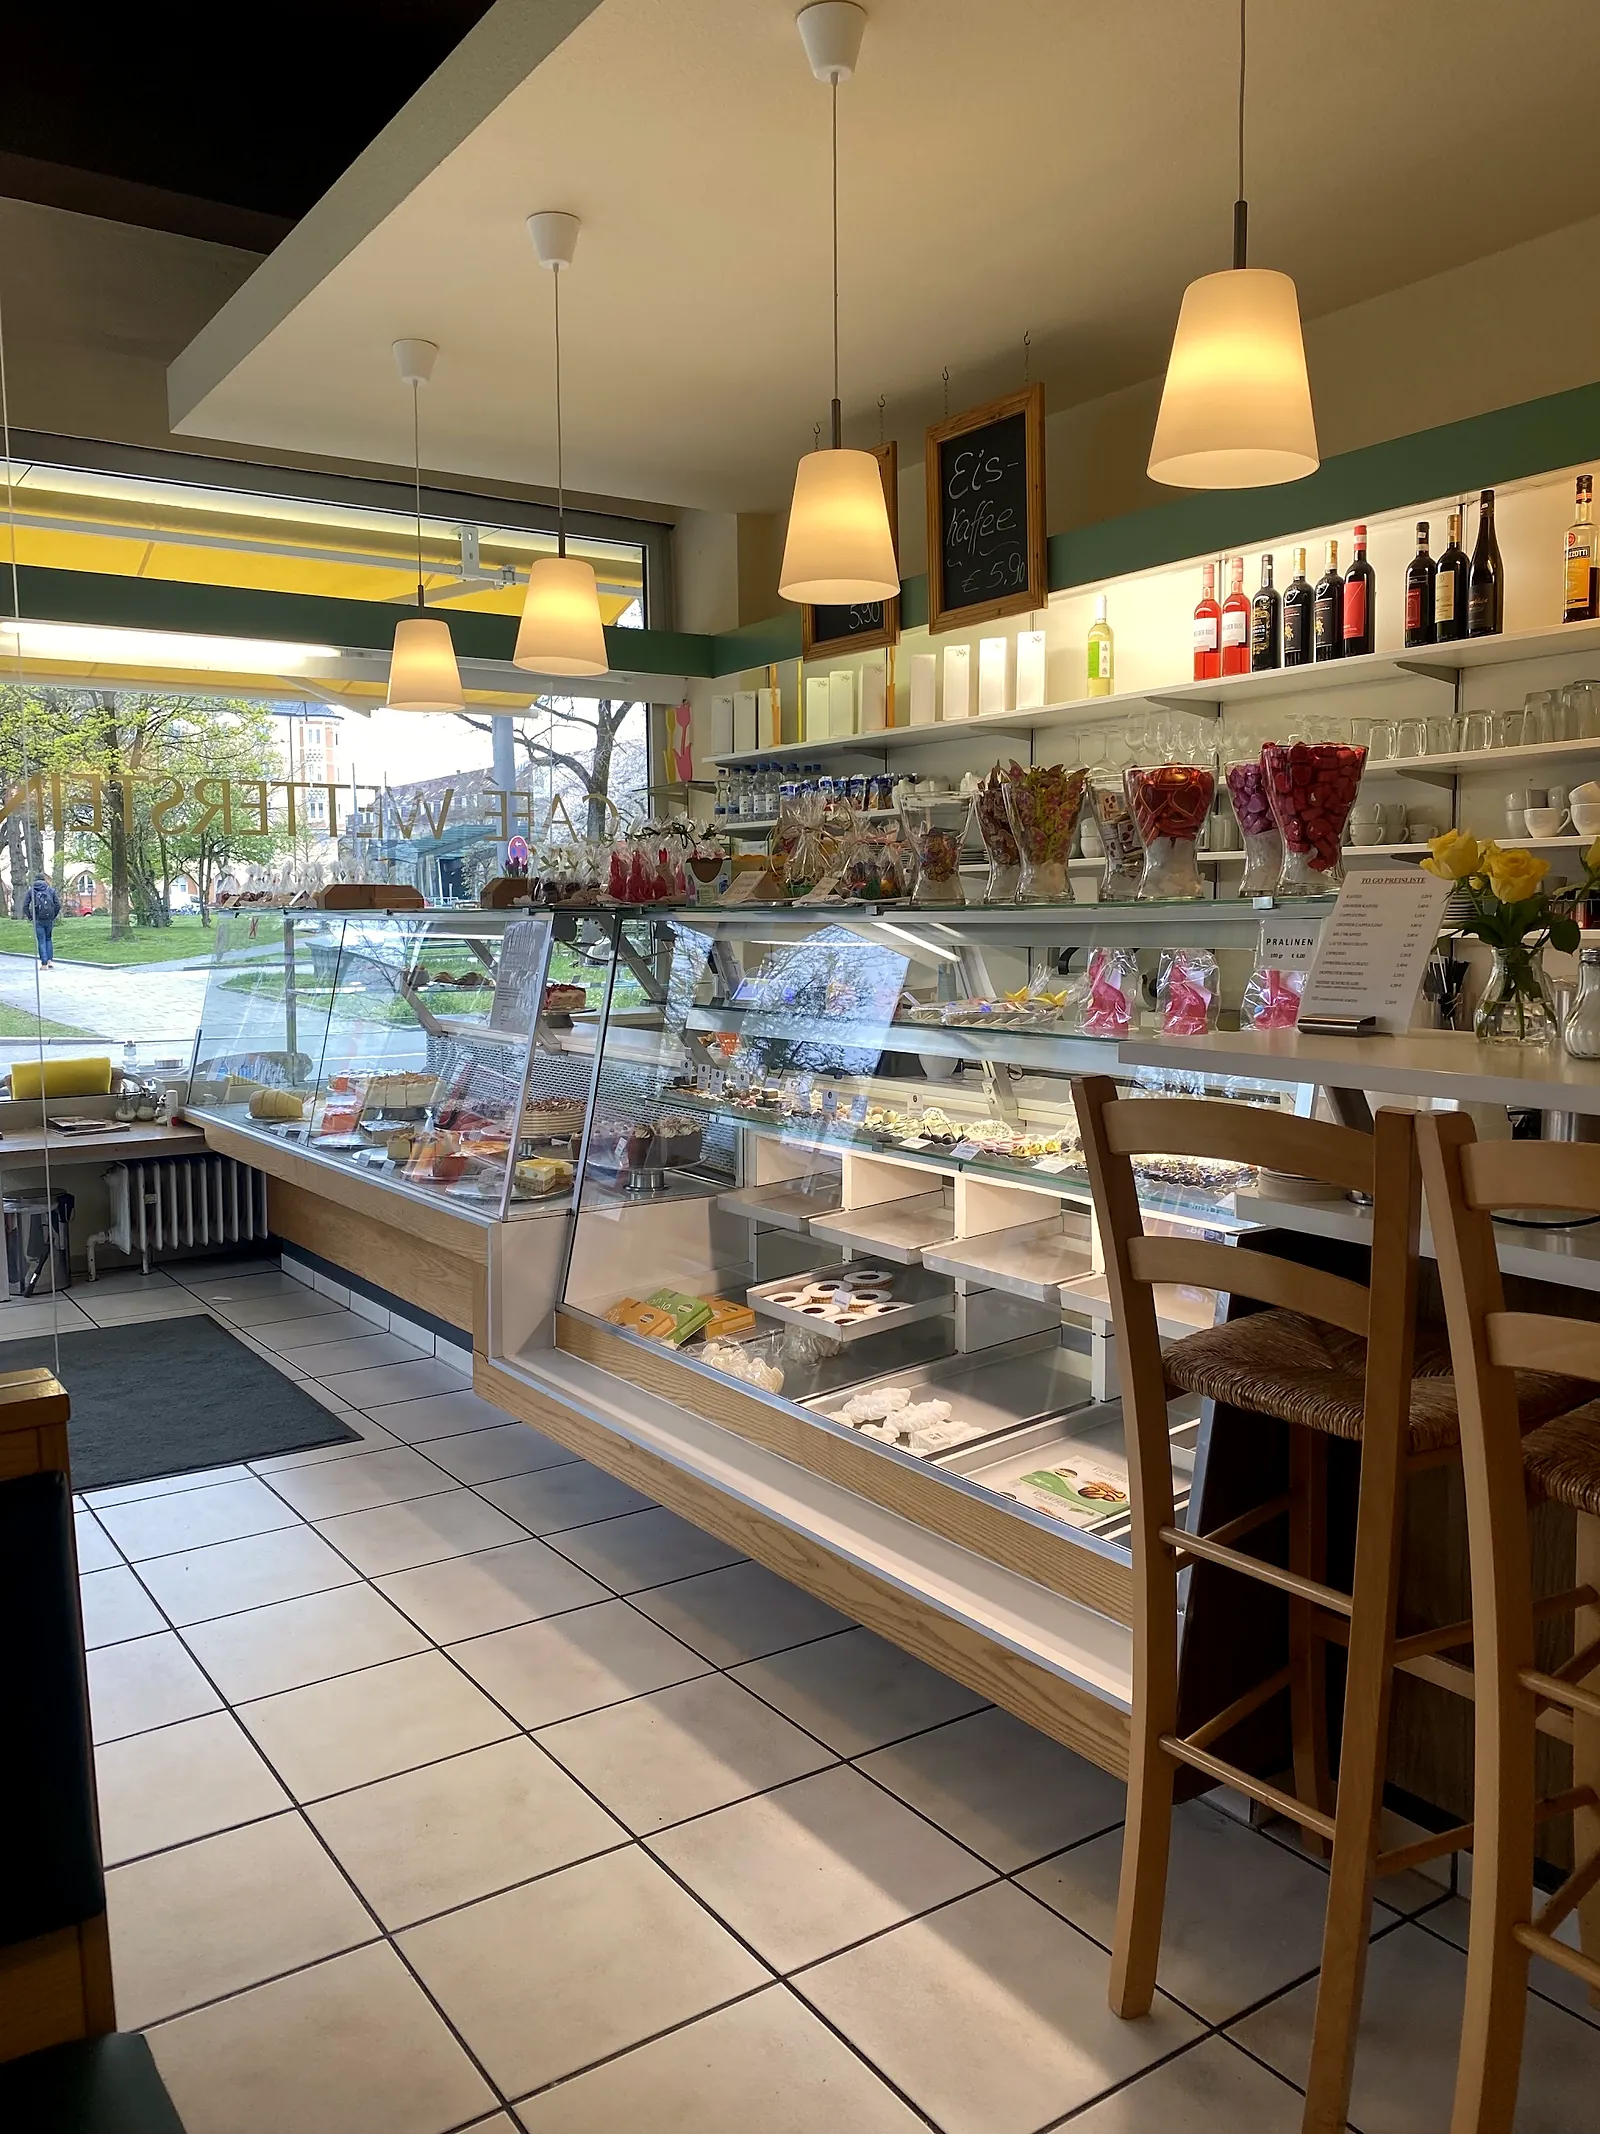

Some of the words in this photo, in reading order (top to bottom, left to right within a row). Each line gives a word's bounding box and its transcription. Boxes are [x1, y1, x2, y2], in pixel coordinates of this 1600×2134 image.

[949, 449, 1019, 500] Eis-
[1361, 877, 1371, 885] TO
[1372, 877, 1384, 885] GO
[1266, 938, 1314, 946] PRALINEN
